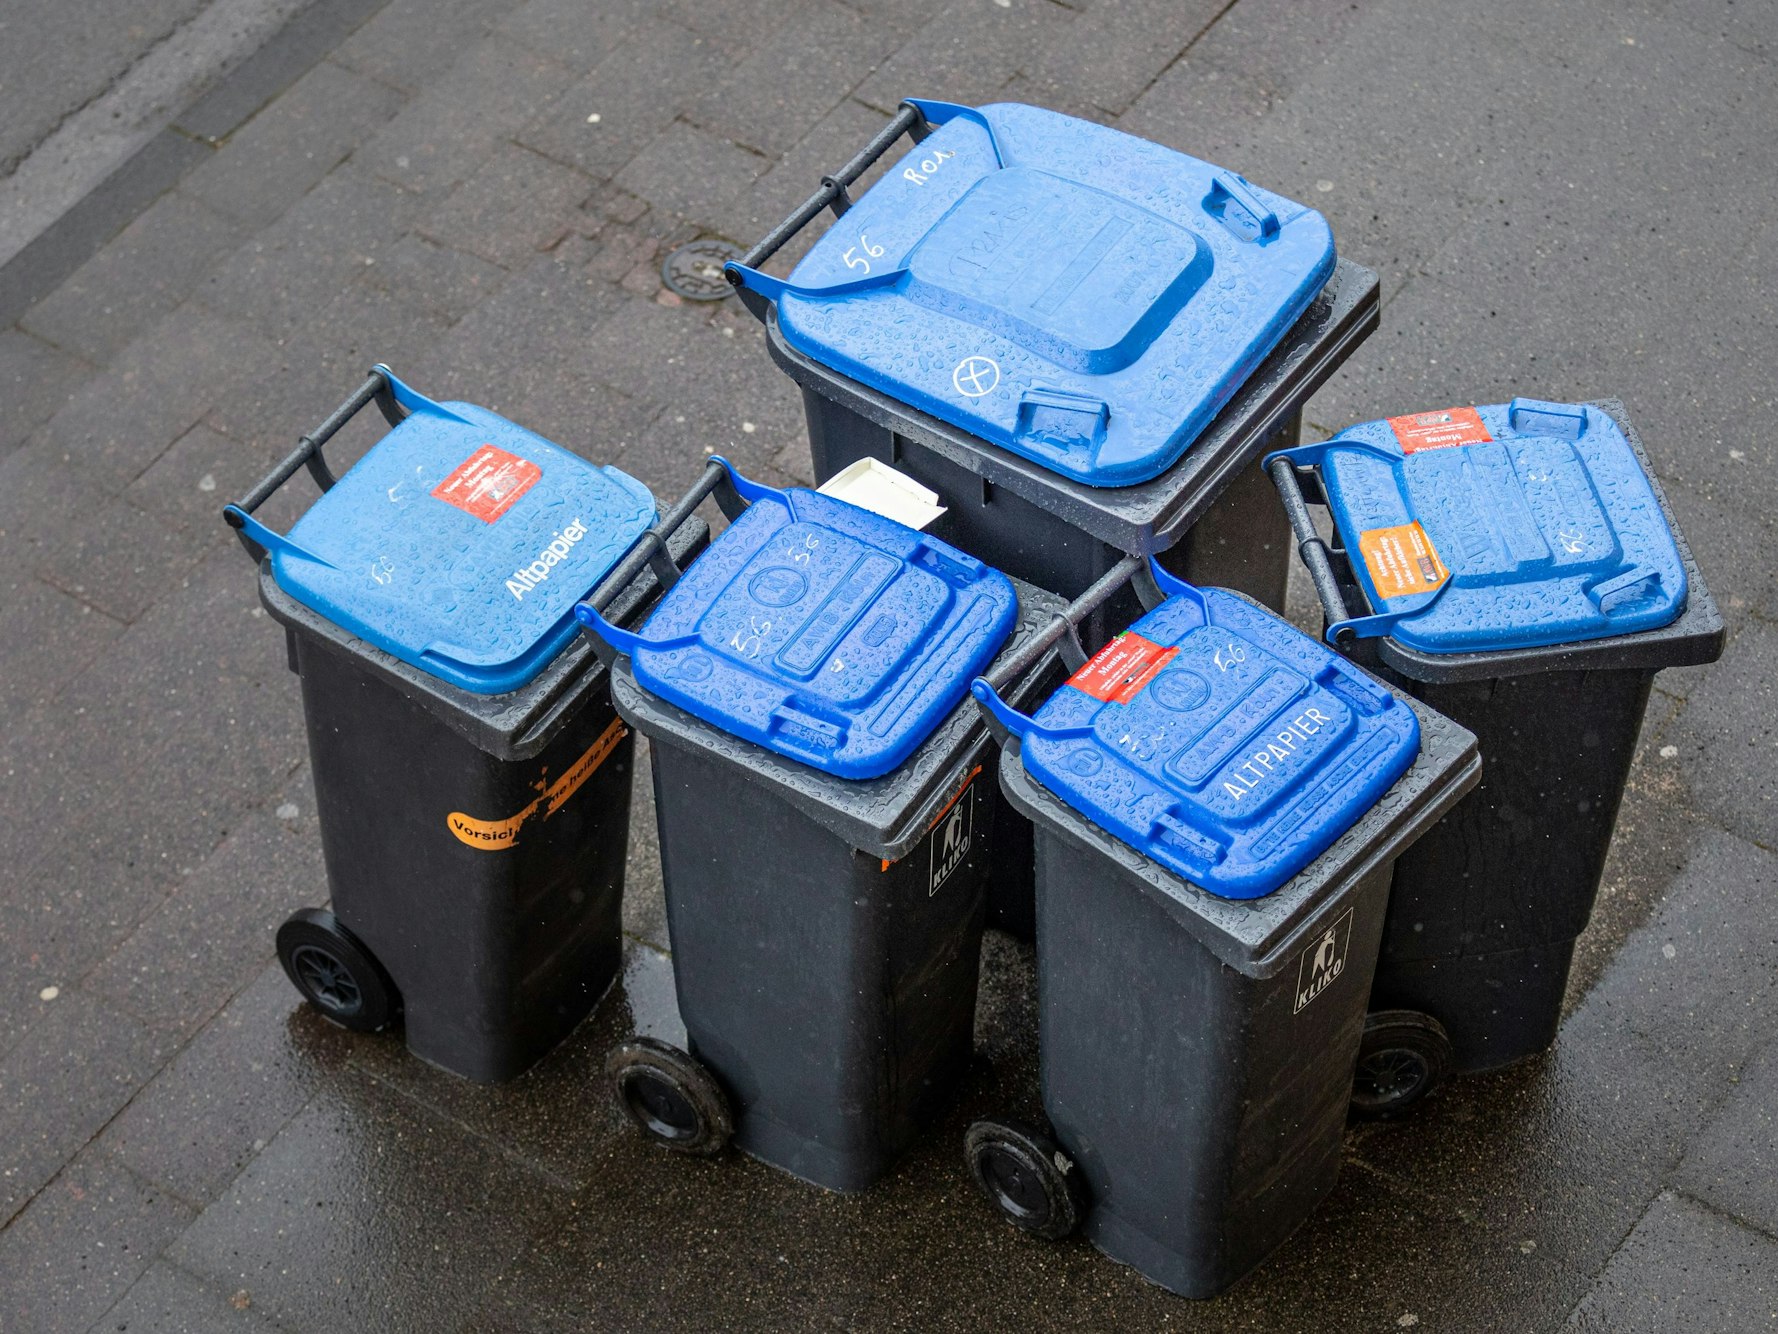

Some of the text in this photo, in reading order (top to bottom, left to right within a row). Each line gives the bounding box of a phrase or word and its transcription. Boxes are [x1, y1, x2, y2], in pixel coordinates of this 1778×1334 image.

[842, 235, 885, 275] 56
[1424, 433, 1463, 443] Montag
[505, 517, 588, 601] Altpapier
[1076, 664, 1097, 681] Neuer
[1098, 650, 1128, 676] Montag
[1223, 707, 1331, 801] ALTPAPIER
[933, 836, 968, 888] KLIKO
[1298, 958, 1342, 1009] KLIKO
